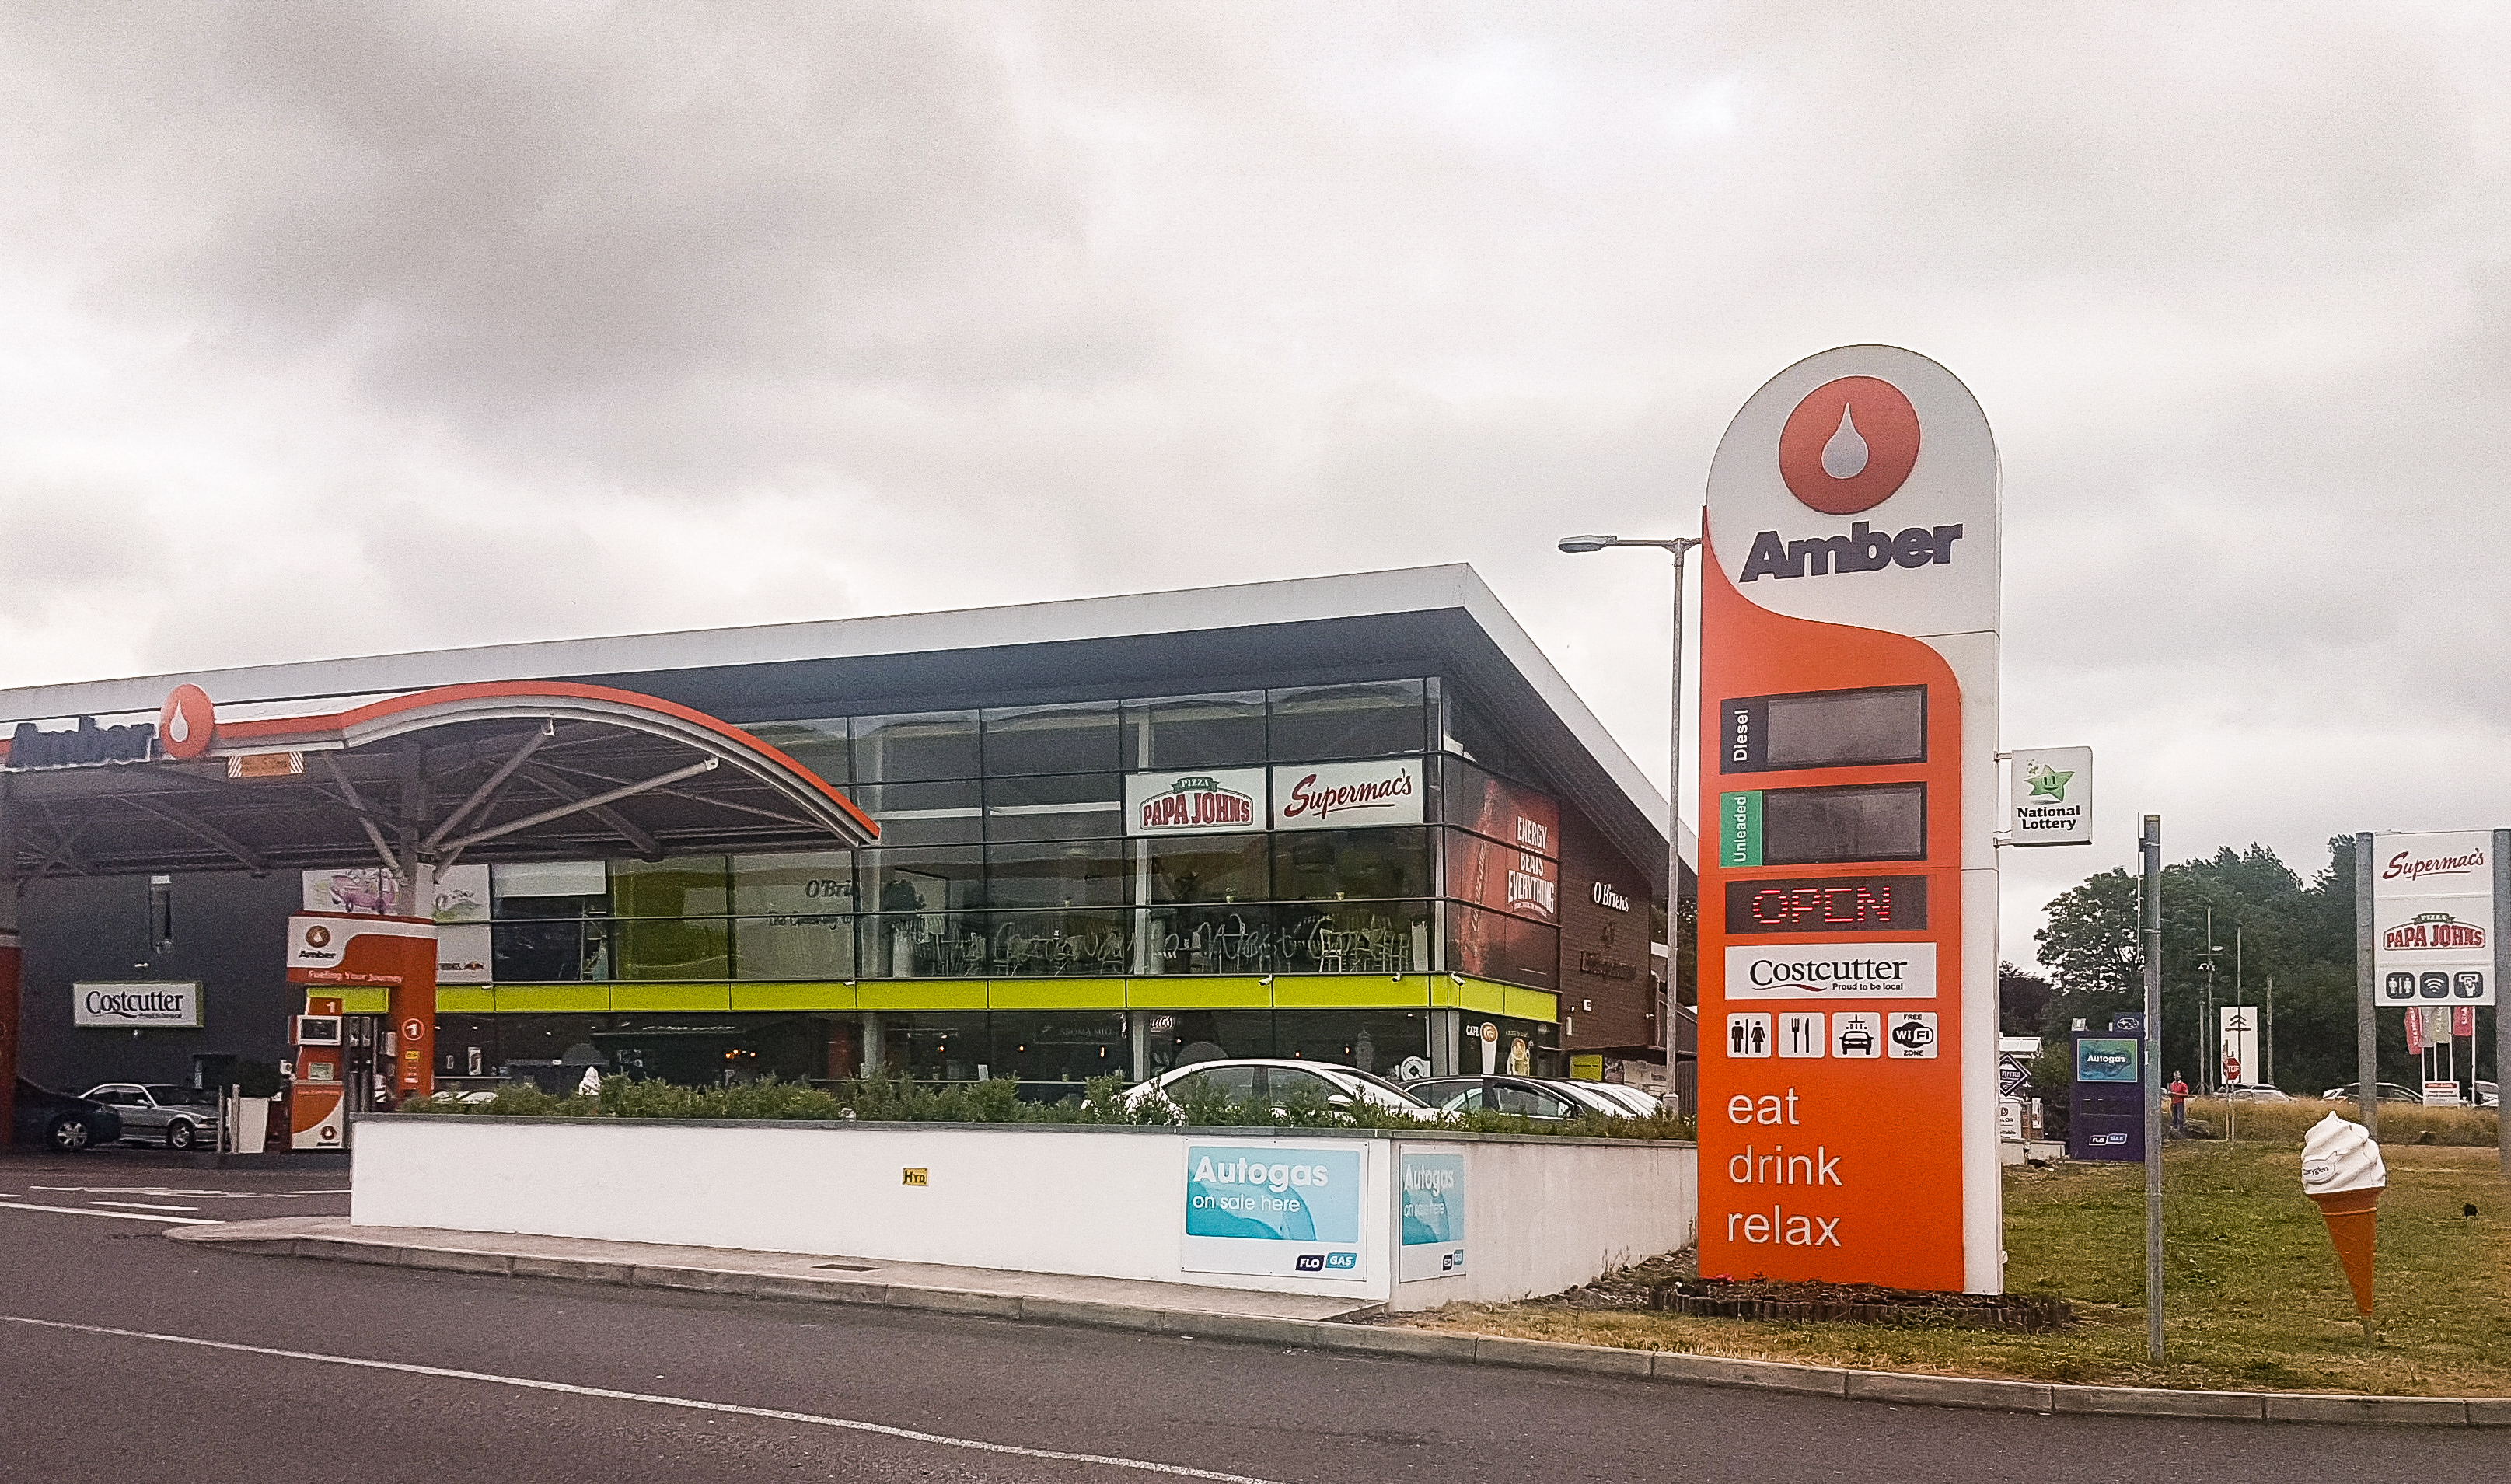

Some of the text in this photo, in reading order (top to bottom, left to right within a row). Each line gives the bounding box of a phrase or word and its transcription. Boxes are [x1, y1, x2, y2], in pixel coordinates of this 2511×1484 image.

[1739, 521, 1963, 583] Amber
[1733, 708, 1748, 763] Diesel
[1180, 777, 1210, 788] PIZZA
[1283, 767, 1412, 820] Supermac's
[1143, 794, 1189, 826] PAPA
[2017, 805, 2081, 818] National
[2022, 819, 2076, 832] Lottery
[1517, 815, 1548, 850] ENERGY
[1734, 795, 1748, 863] Unleaded
[1520, 845, 1545, 877] BEATS
[2382, 847, 2484, 882] Supermac's
[1507, 868, 1555, 914] EVERYTHING
[2386, 925, 2427, 948] PAPA
[298, 950, 336, 959] Amber
[1749, 958, 1908, 986] Costcutter
[86, 990, 183, 1014] Costcutter
[326, 1000, 336, 1014] 1
[406, 1022, 418, 1036] 1
[2087, 1054, 2126, 1064] Autogas
[1727, 1087, 1801, 1126] eat
[1193, 1155, 1329, 1193] Autogas
[1403, 1163, 1455, 1197] Autogas
[1728, 1145, 1844, 1187] drink
[1192, 1193, 1301, 1213] on sale here
[1403, 1204, 1413, 1217] on
[1727, 1205, 1842, 1248] relax
[1299, 1255, 1353, 1269] FLO GAS
